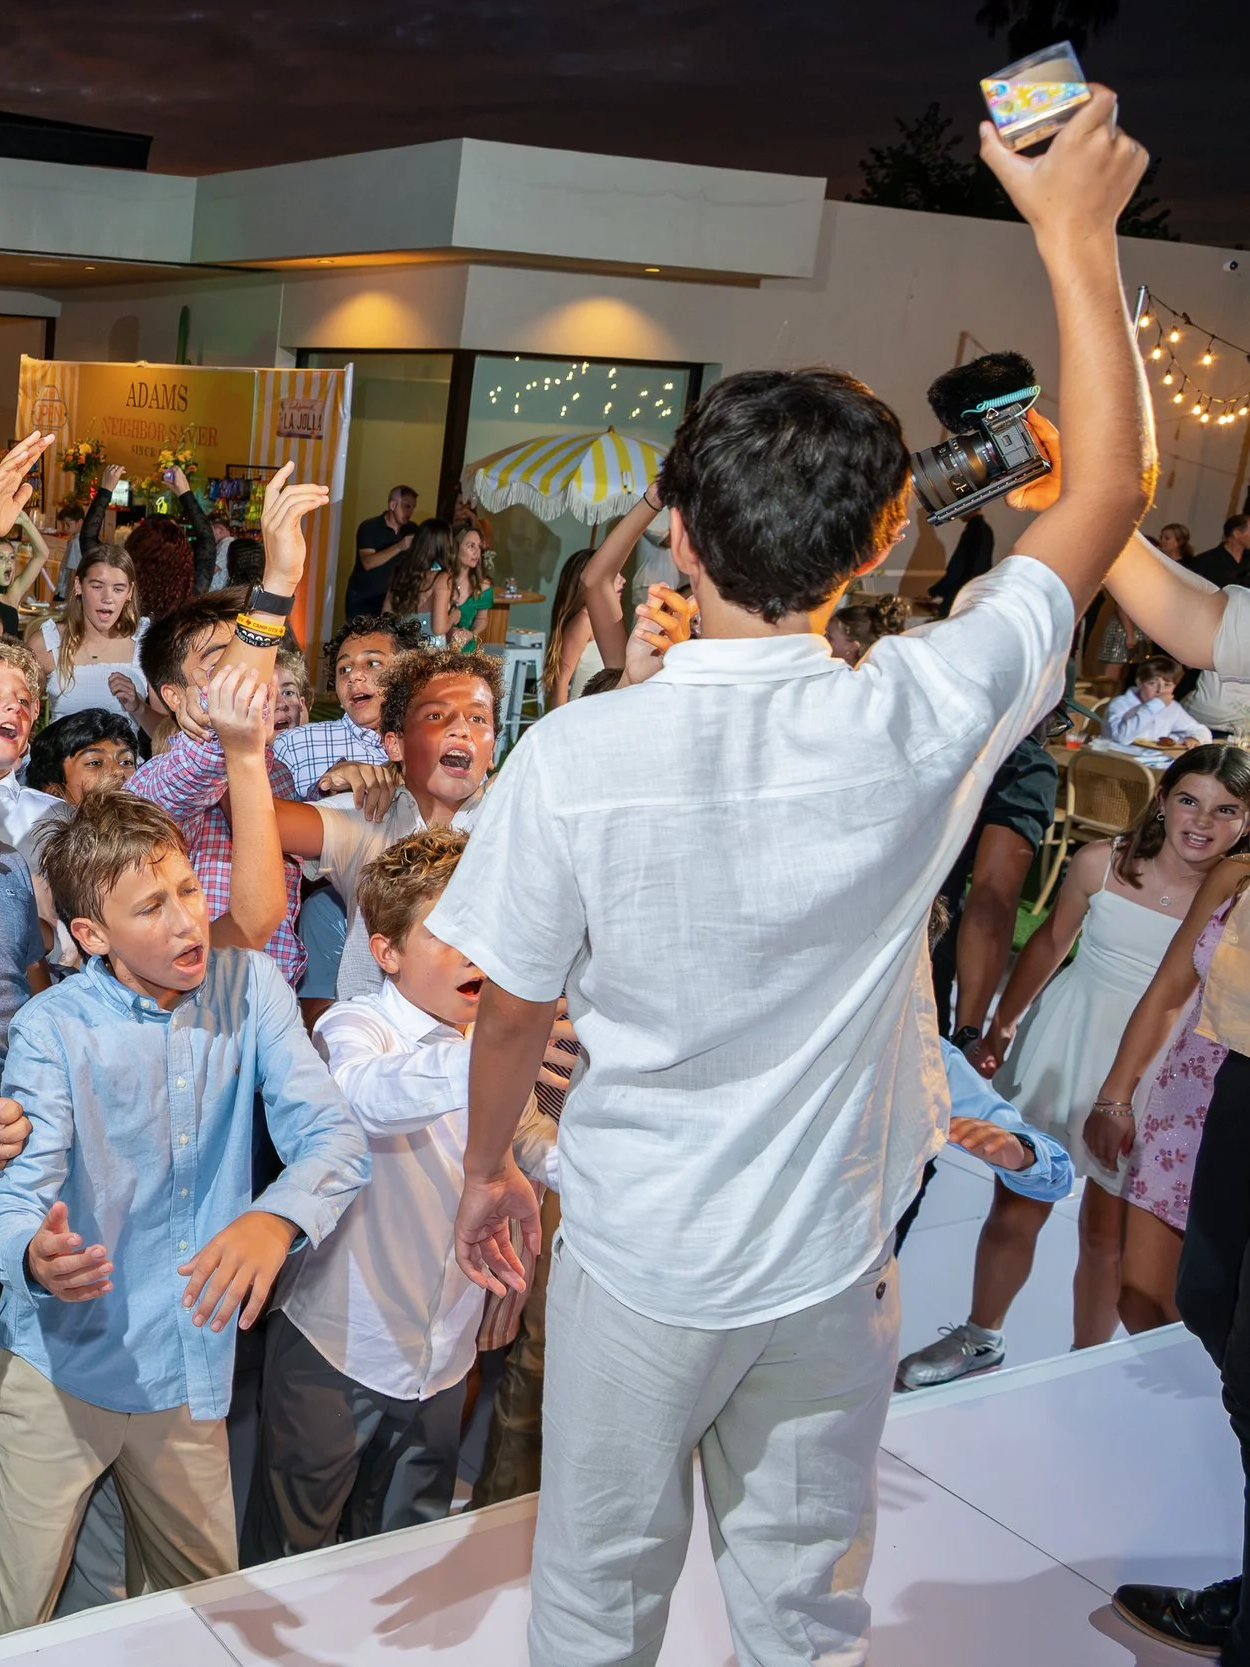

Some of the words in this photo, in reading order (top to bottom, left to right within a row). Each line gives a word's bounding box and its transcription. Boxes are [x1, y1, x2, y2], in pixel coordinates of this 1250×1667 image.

[126, 381, 188, 412] ADAMS
[101, 416, 165, 442] NEIGHBOR
[131, 445, 156, 457] SINCE
